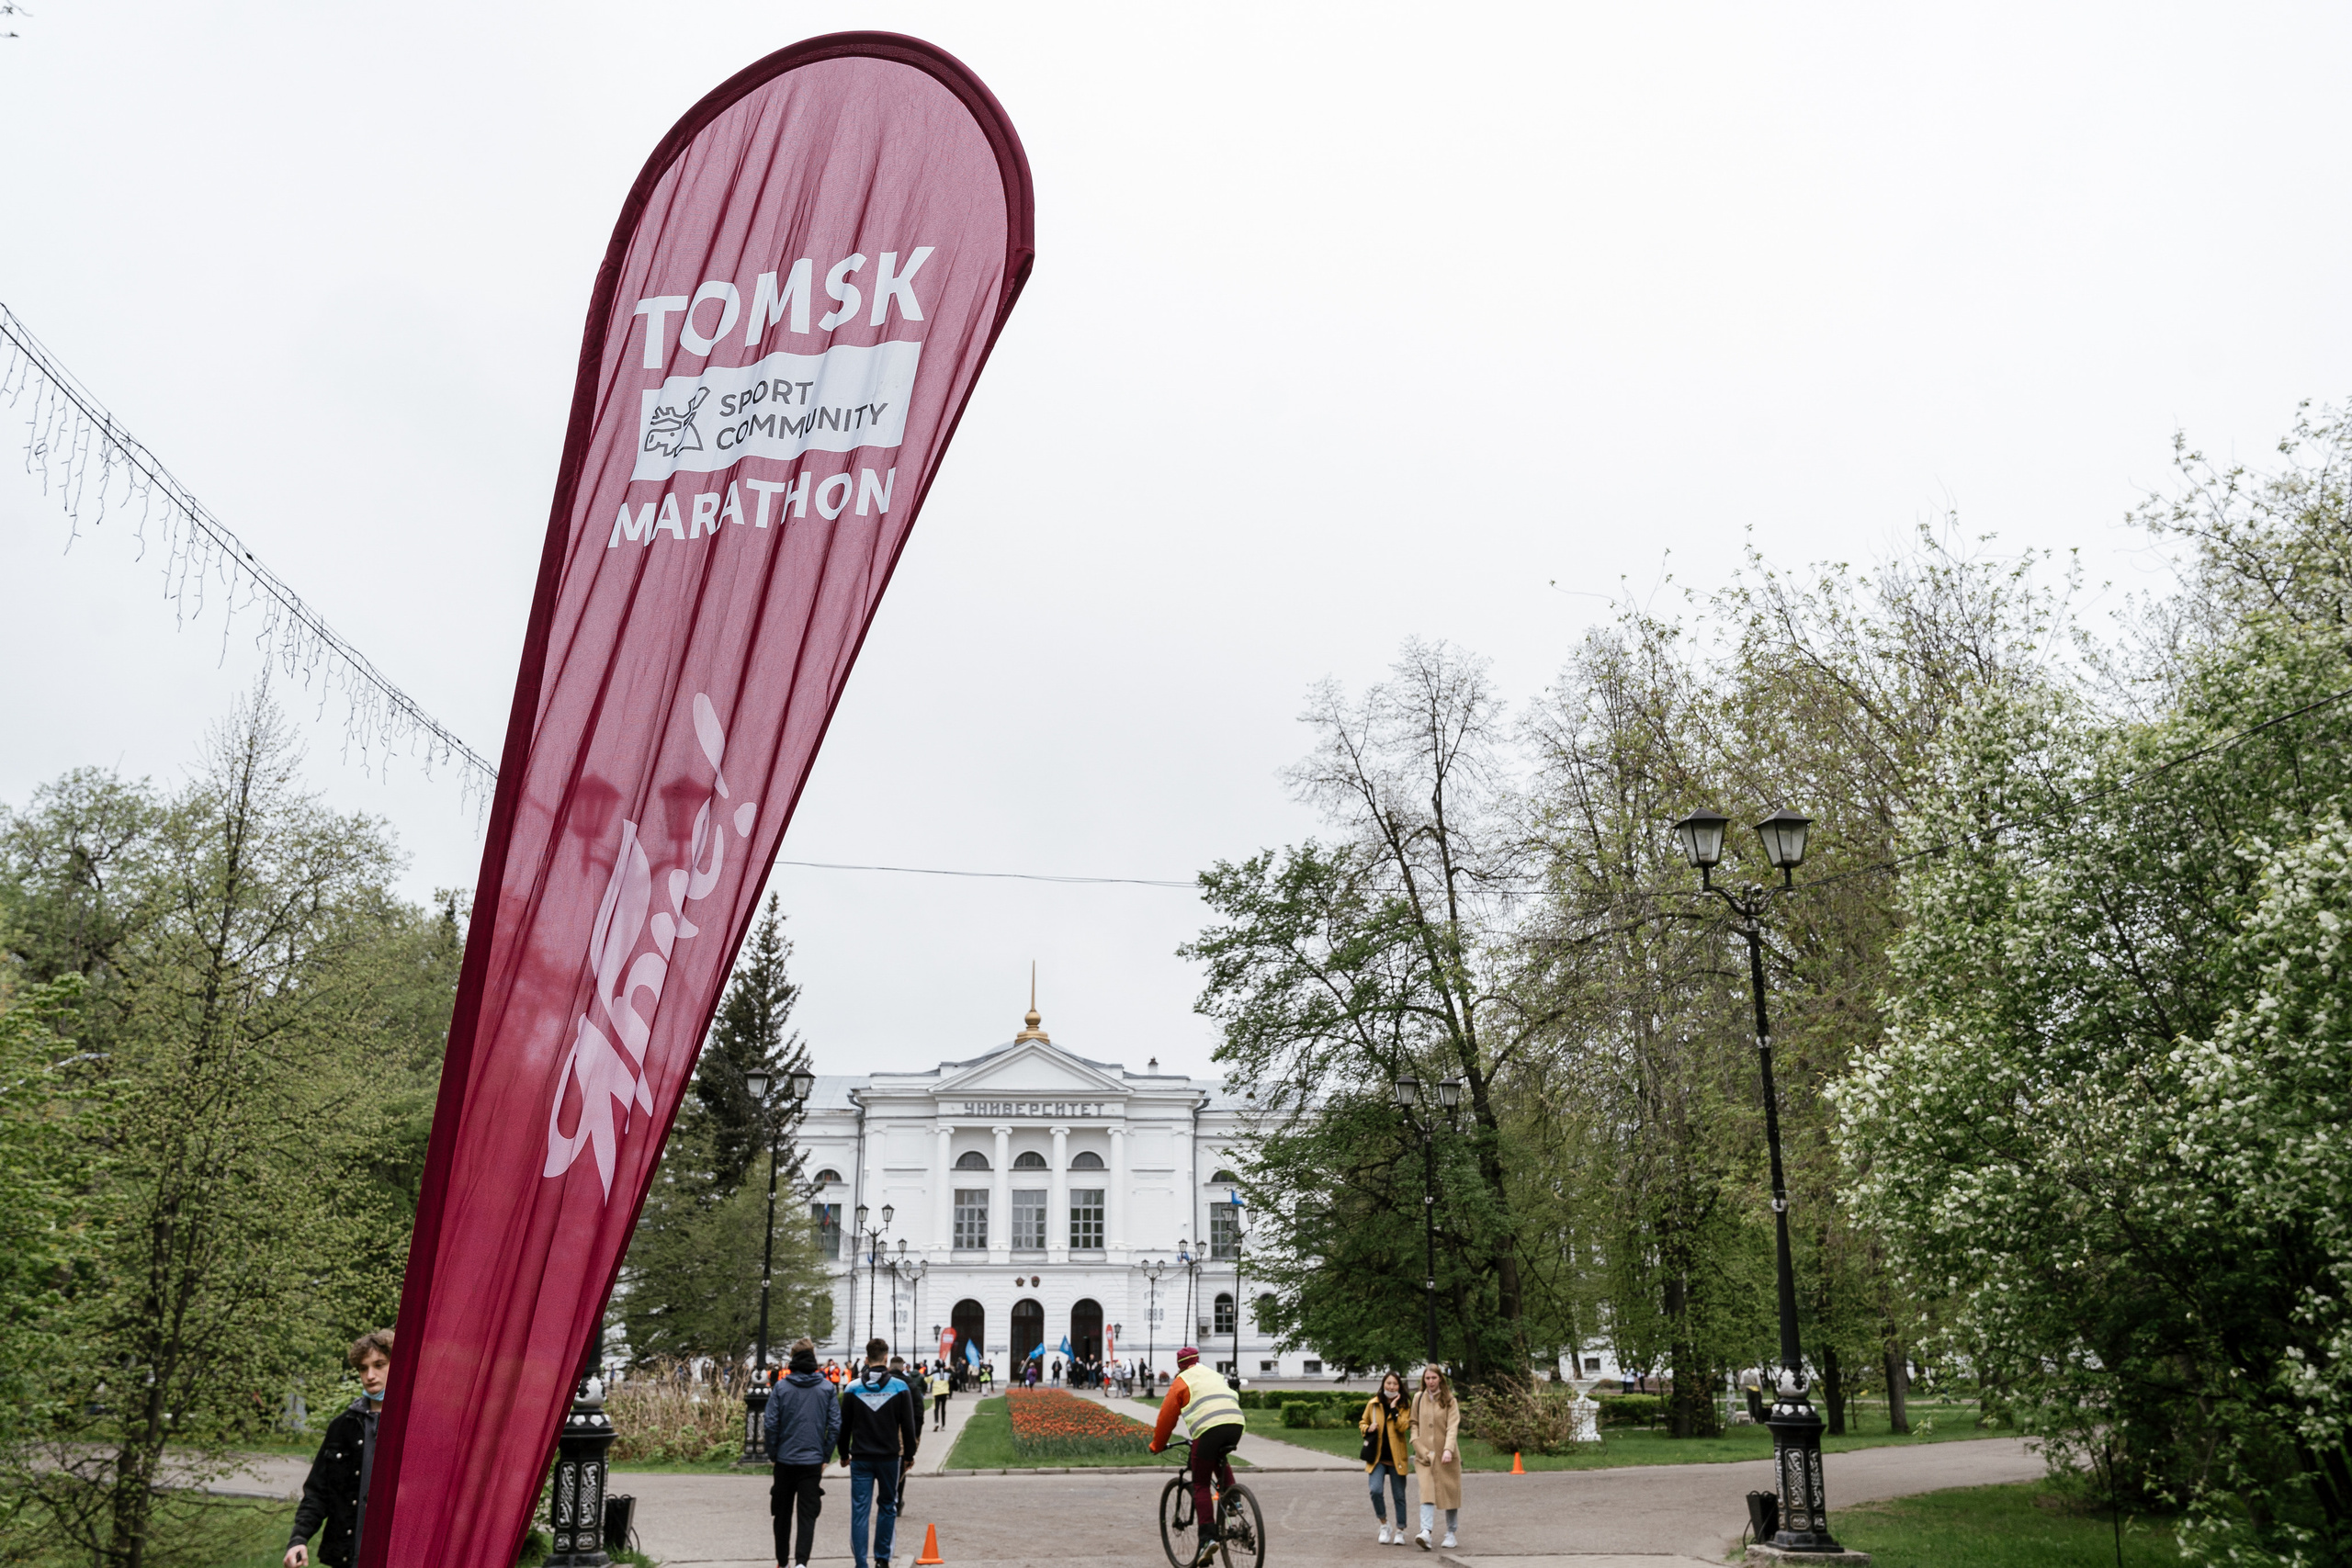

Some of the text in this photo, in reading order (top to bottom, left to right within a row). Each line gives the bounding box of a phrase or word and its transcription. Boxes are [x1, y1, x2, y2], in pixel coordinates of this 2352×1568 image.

[633, 246, 935, 369] TOMSK
[719, 378, 814, 417] SPORT
[716, 402, 888, 450] COMMUNITY
[608, 467, 896, 548] MARATHON
[965, 1102, 1105, 1116] УНИВЕРСИТЕТ
[889, 1310, 908, 1323] 178
